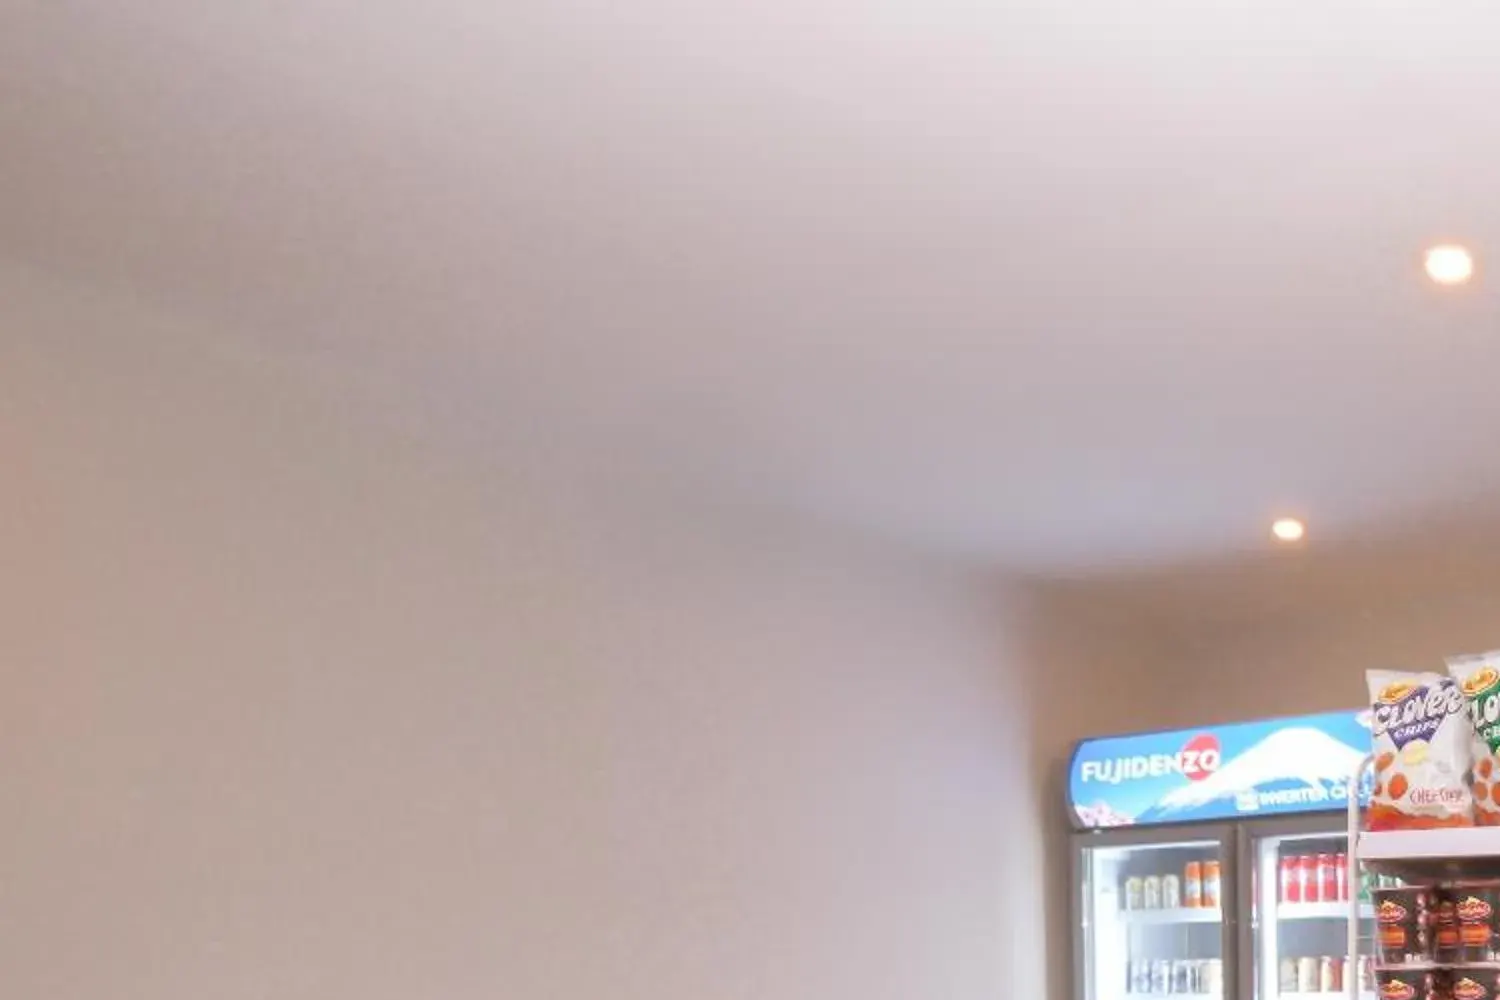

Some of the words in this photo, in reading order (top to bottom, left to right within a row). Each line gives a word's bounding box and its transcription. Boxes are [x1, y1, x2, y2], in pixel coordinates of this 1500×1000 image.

[1374, 681, 1464, 737] CLOVER
[1394, 718, 1440, 739] CHIPS
[1081, 748, 1221, 784] FUJIDENZO
